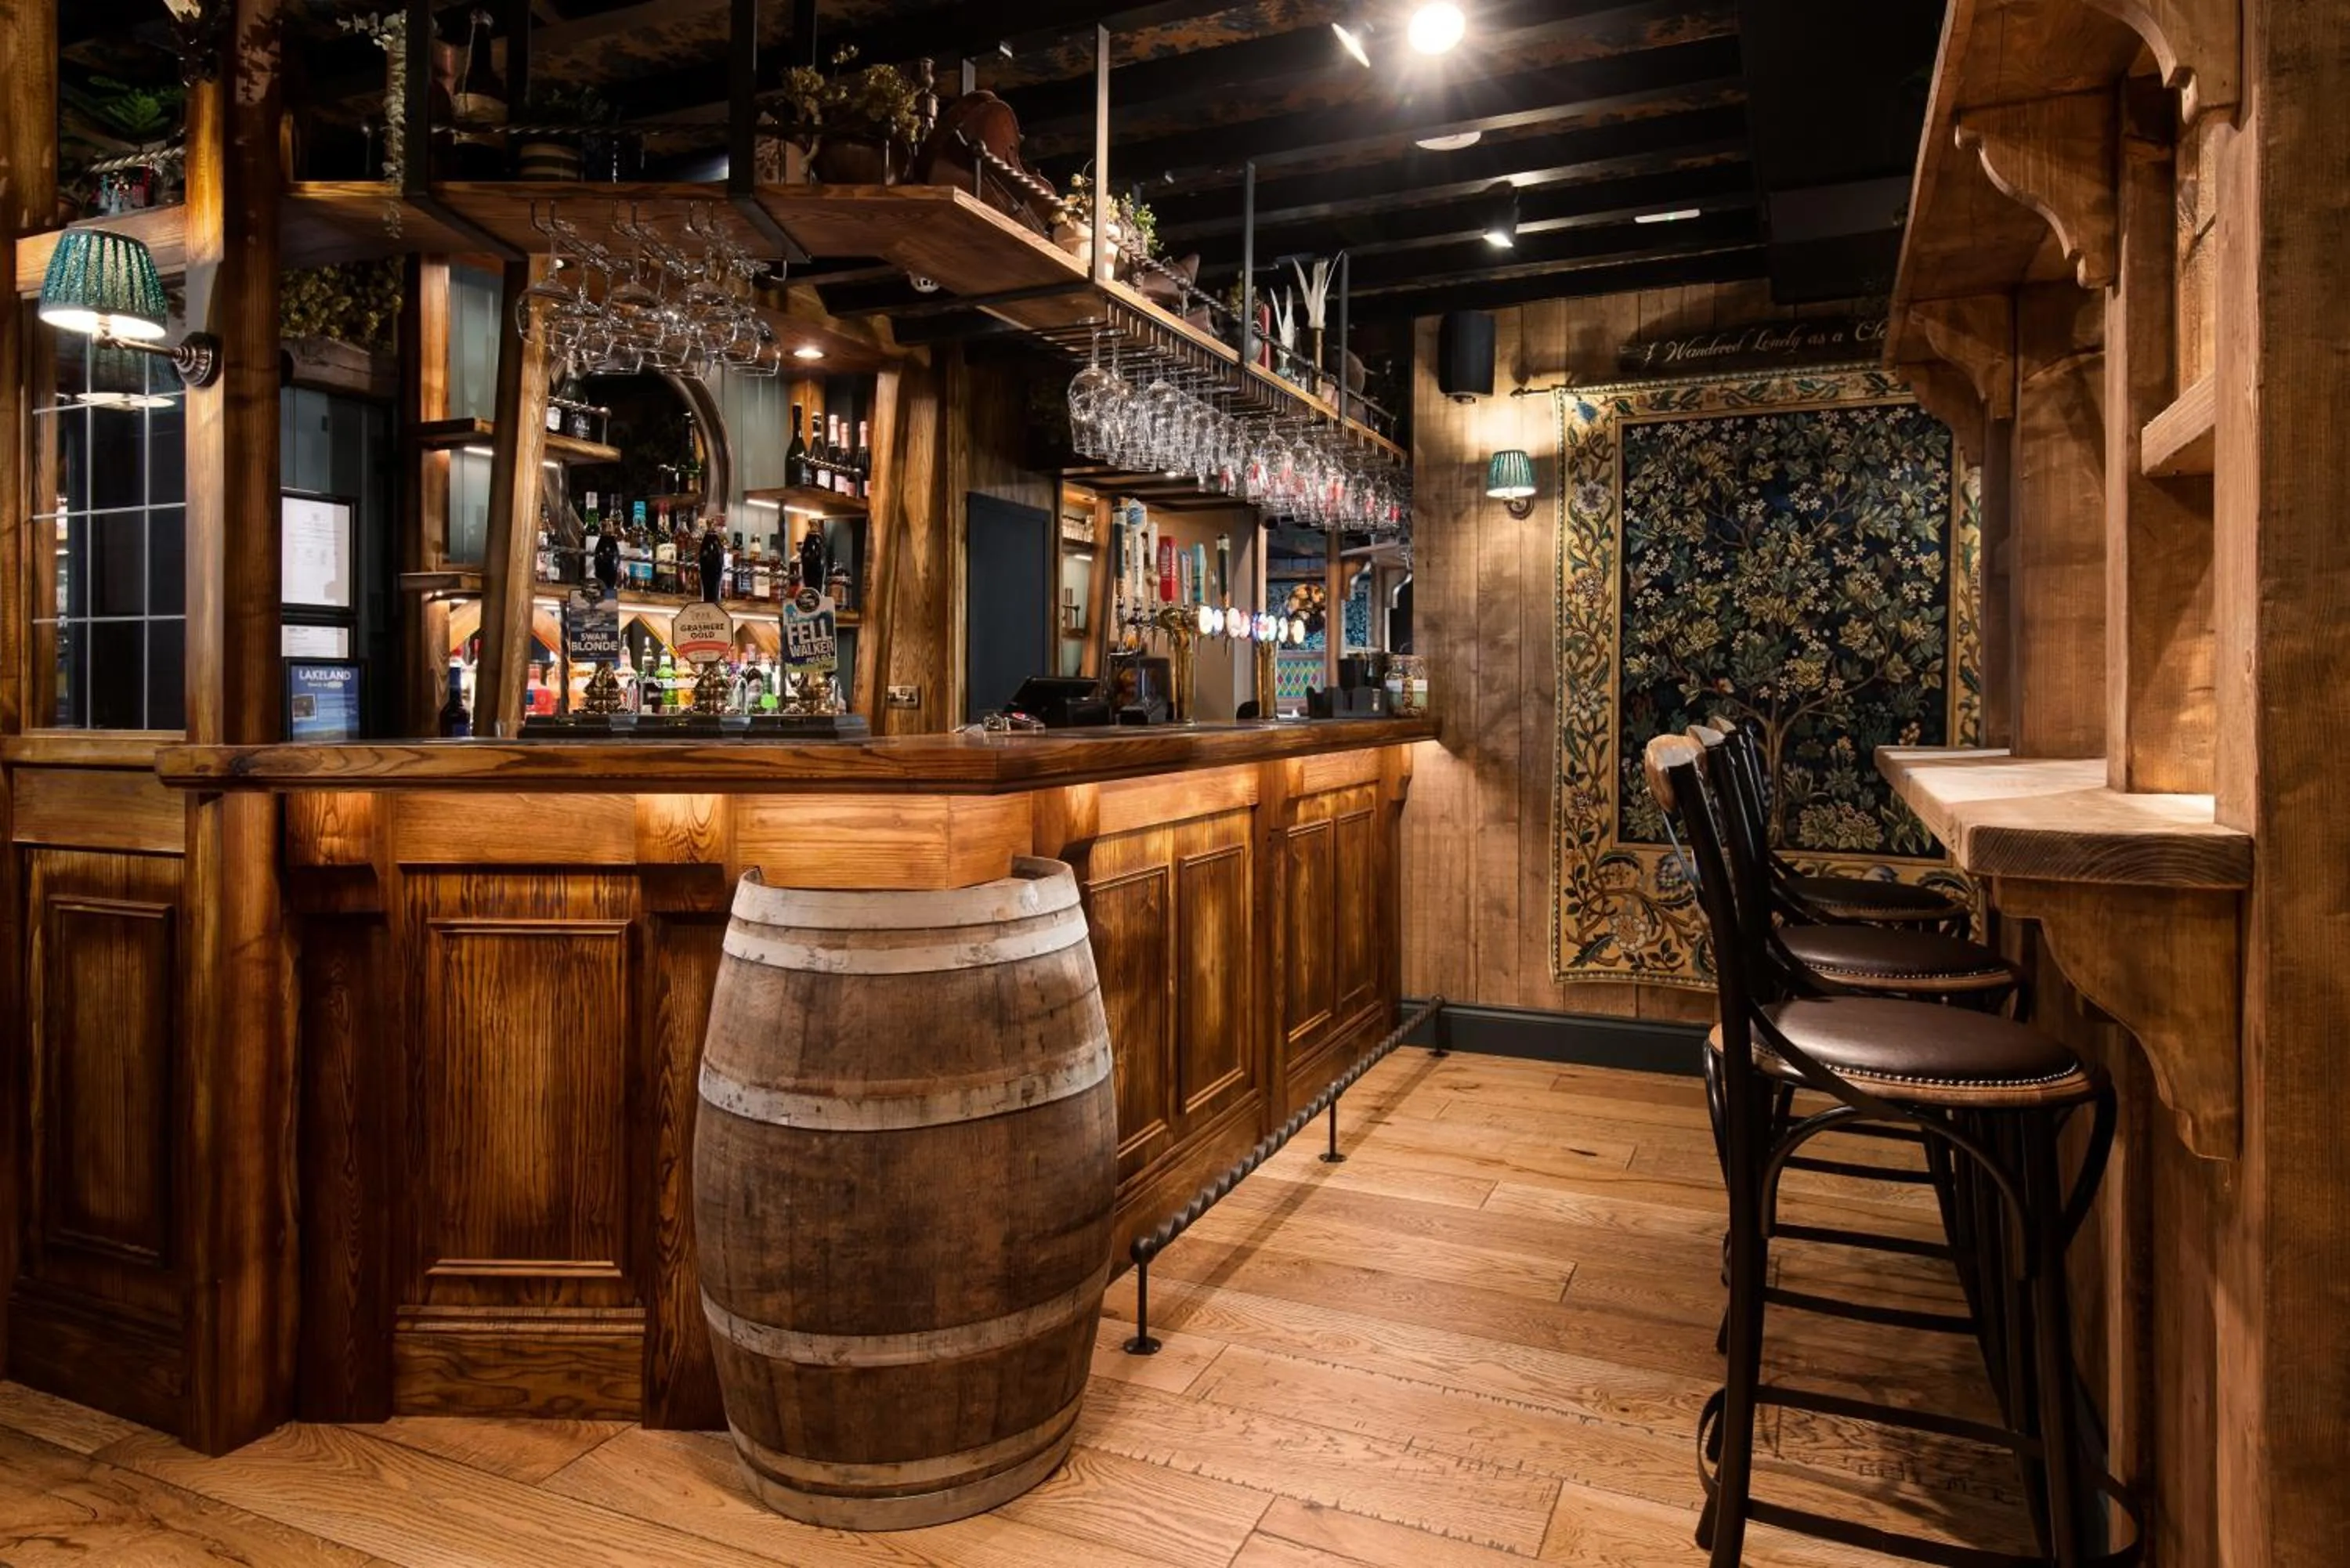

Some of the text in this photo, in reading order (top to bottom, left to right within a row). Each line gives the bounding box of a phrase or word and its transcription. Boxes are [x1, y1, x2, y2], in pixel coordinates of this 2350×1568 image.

[1665, 329, 1753, 363] Wandered
[1754, 322, 1804, 356] Lonely
[1808, 333, 1825, 345] as
[1831, 333, 1843, 342] a
[680, 623, 725, 631] GRASMERE
[786, 619, 833, 645] FELL
[580, 632, 608, 641] SWAN
[571, 641, 618, 651] BLONDE
[789, 641, 835, 657] WALKER
[298, 669, 352, 681] LAKELAND
